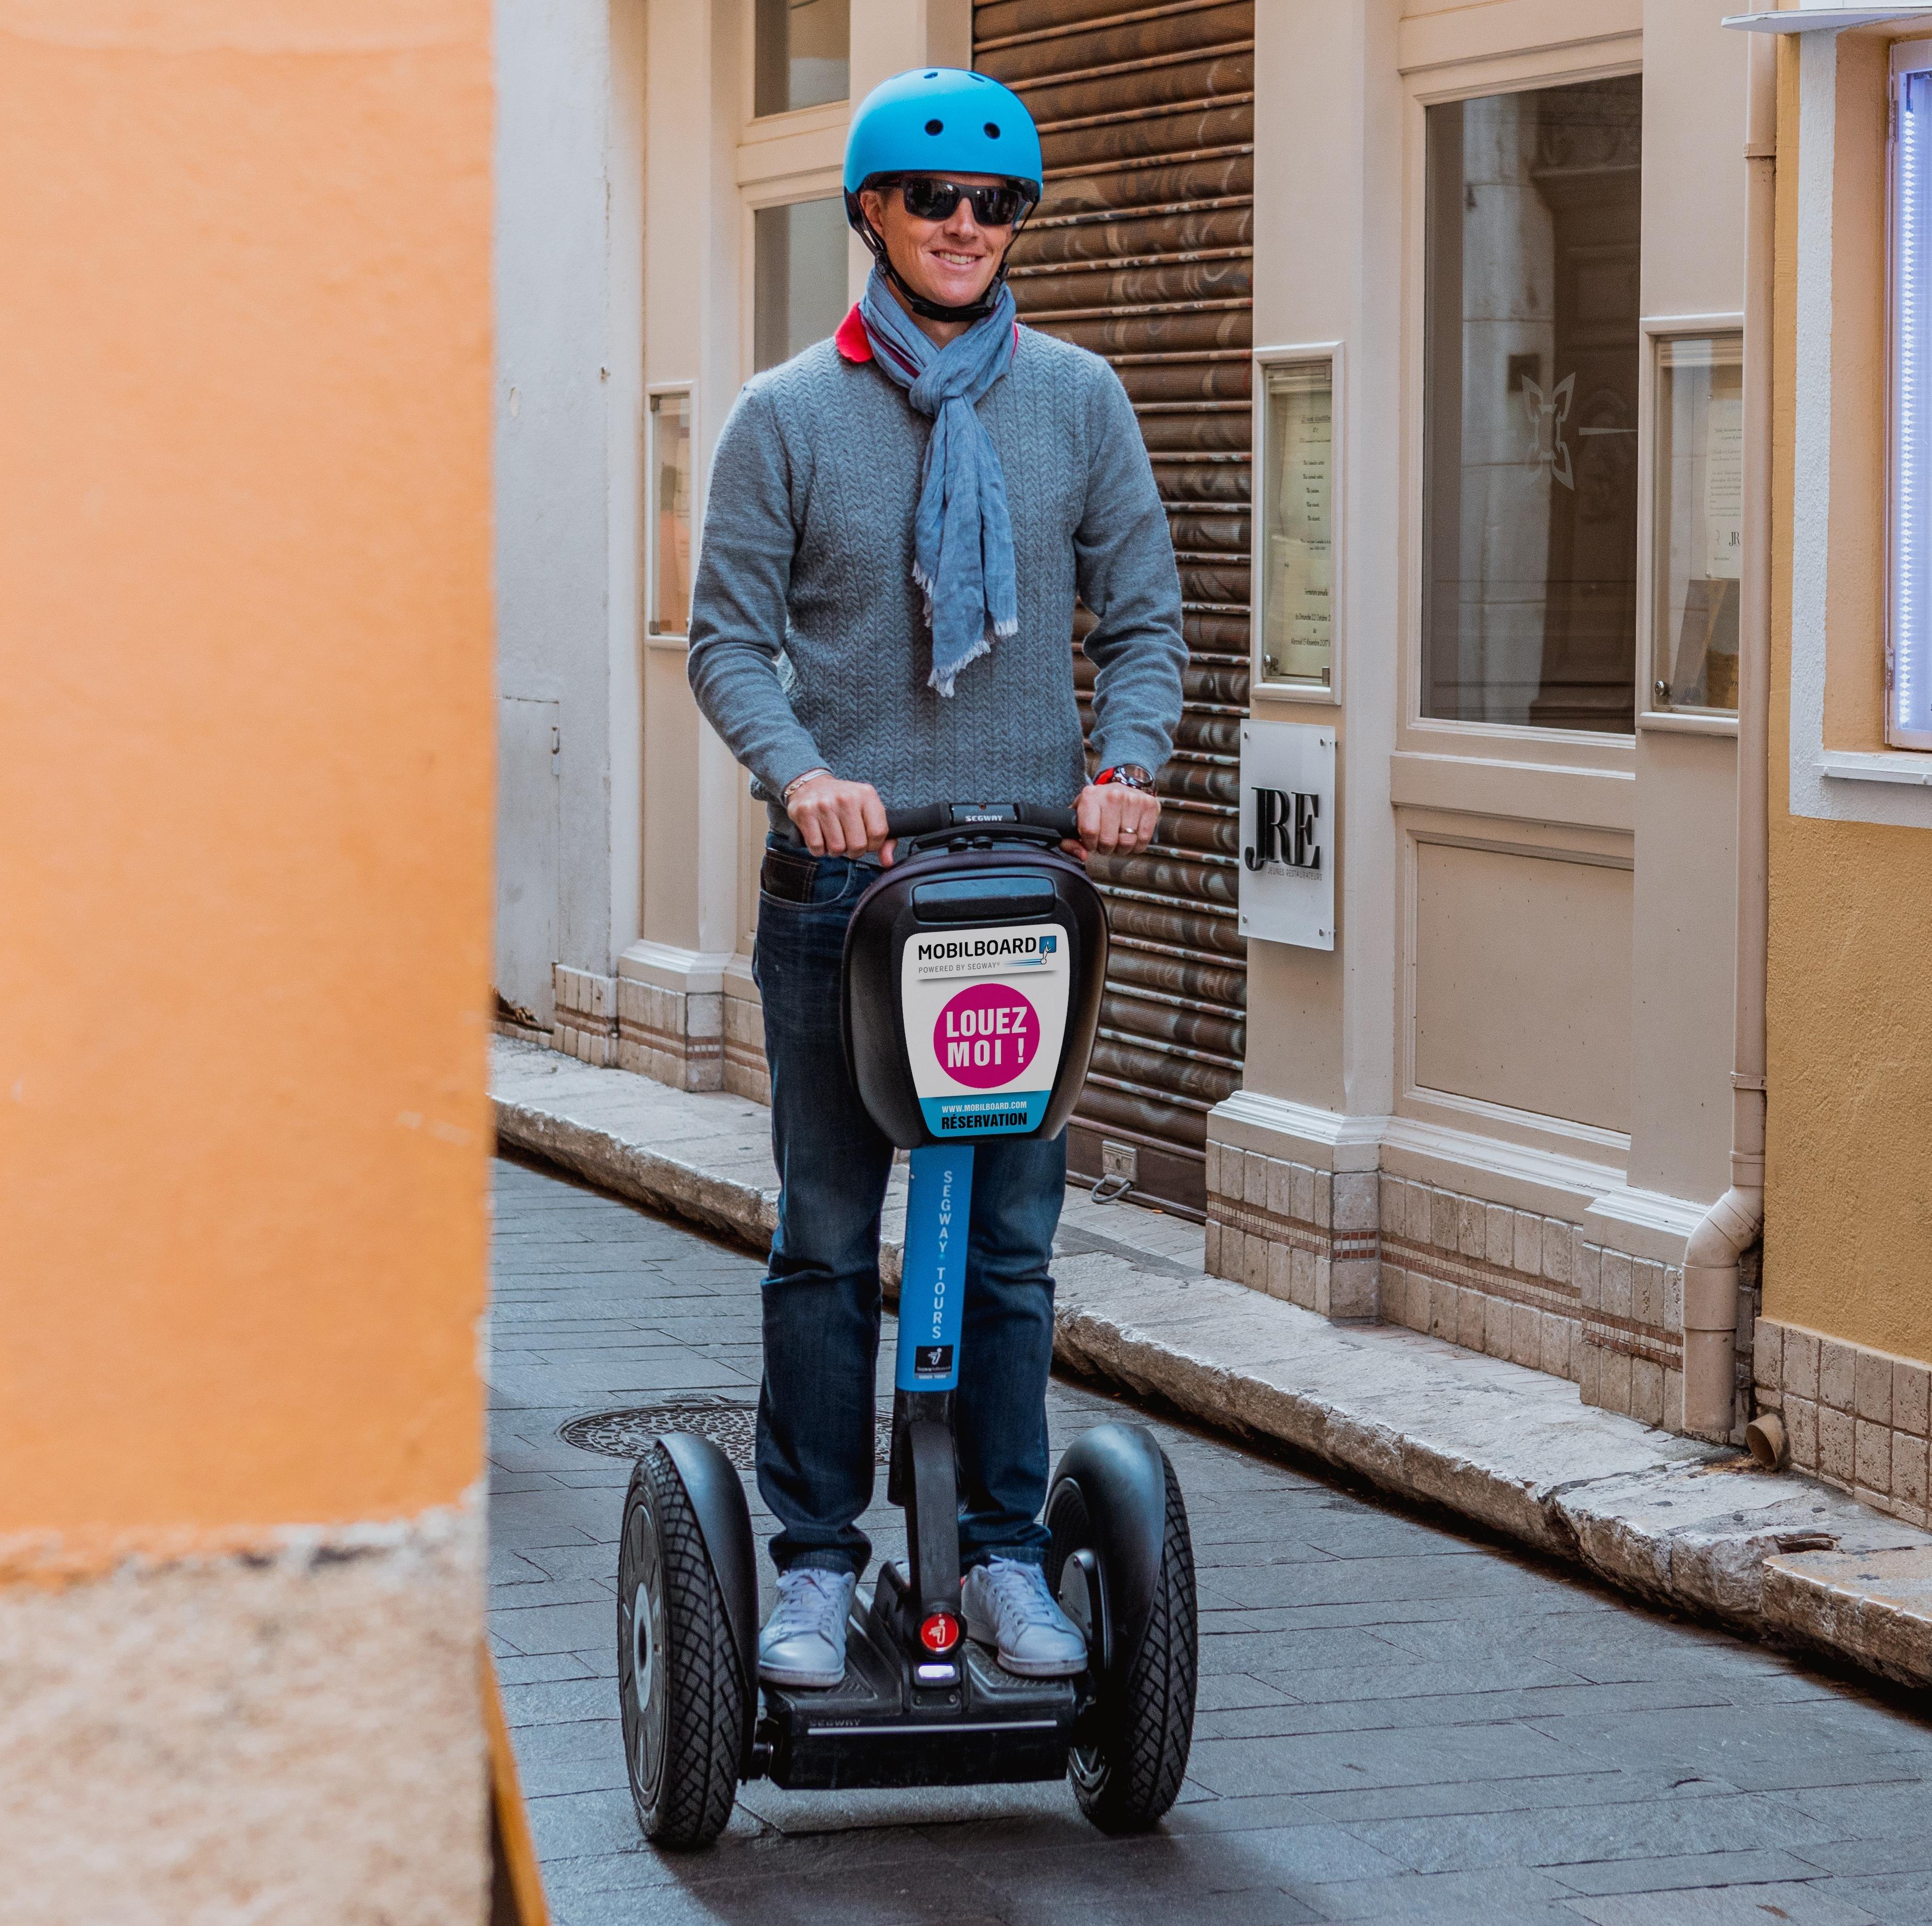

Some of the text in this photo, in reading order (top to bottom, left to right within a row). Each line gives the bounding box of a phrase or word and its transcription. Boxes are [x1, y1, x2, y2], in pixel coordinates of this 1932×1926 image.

[1245, 787, 1320, 871] JRE
[918, 937, 1037, 960] MOBILBOARD
[918, 965, 953, 973] POWERED
[947, 1006, 1027, 1038] LOUEZ
[948, 1039, 1002, 1068] MOI
[942, 1101, 1027, 1113] WWW.MOBILBOARD.COM
[941, 1112, 1027, 1130] RÉSERVATION
[931, 1267, 946, 1339] TOURS
